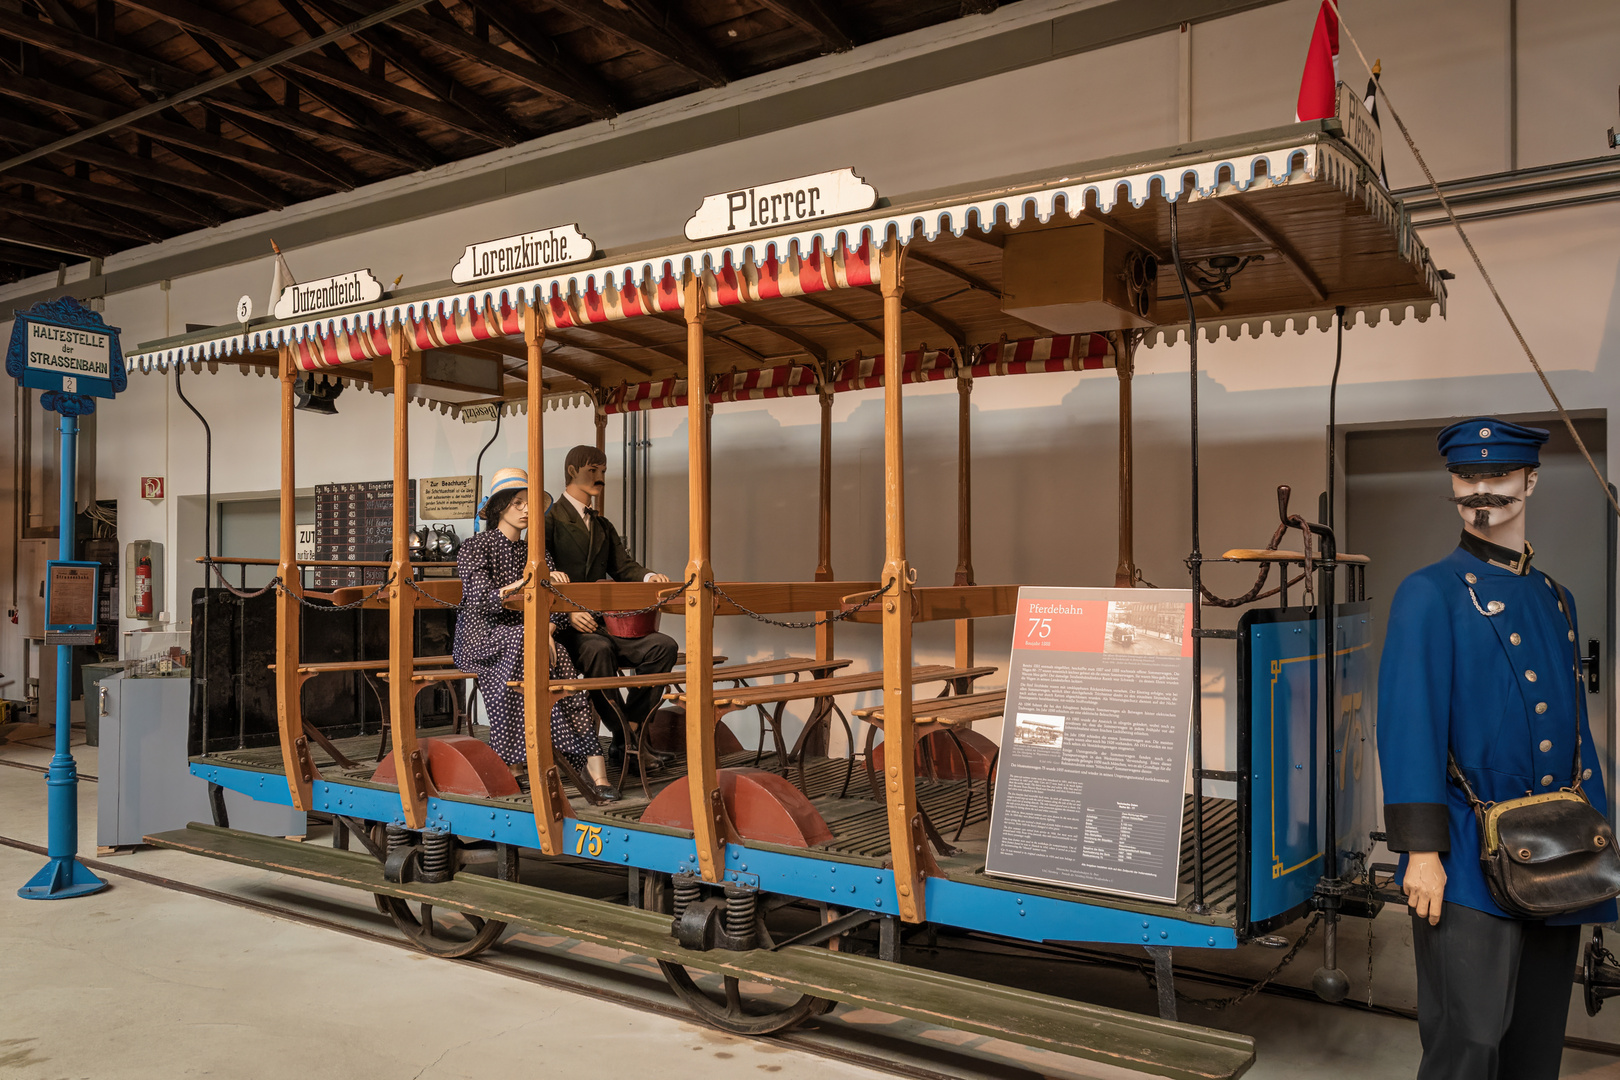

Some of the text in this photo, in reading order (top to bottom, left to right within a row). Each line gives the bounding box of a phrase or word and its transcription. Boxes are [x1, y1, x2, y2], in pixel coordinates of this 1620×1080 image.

[727, 186, 824, 231] Plerrer.
[471, 231, 572, 277] Lorenzkirche.
[292, 273, 365, 314] Dutzendteich.
[240, 302, 247, 316] 5
[33, 325, 105, 348] HALTESTELLE
[62, 344, 74, 354] der
[30, 352, 108, 374] STRASSENBAHN
[67, 380, 73, 390] 2
[1480, 448, 1488, 458] 9
[1029, 604, 1083, 615] Pferdebahn
[1027, 618, 1052, 638] 75
[1339, 691, 1363, 791] 75
[575, 823, 603, 857] 75
